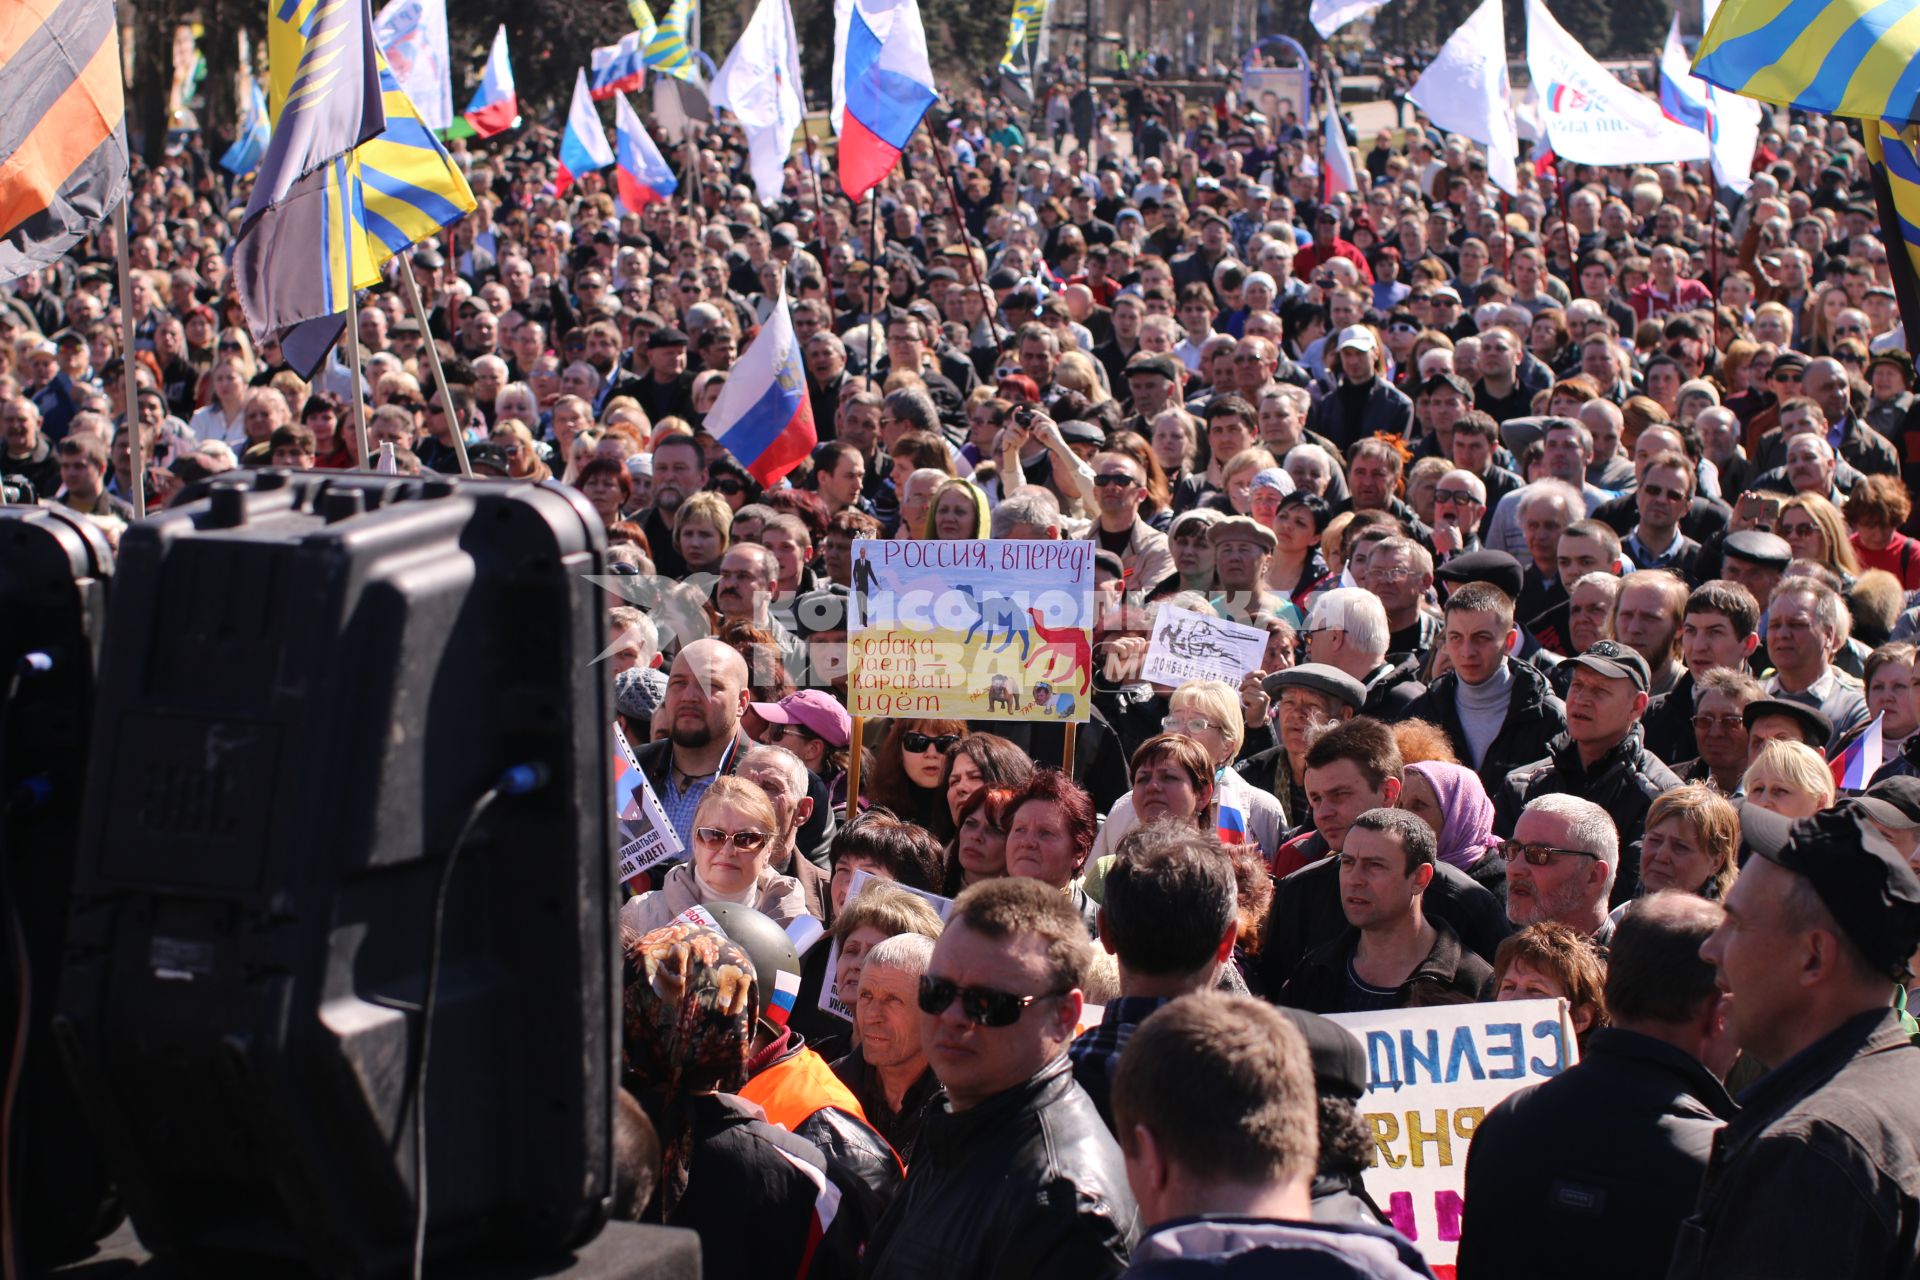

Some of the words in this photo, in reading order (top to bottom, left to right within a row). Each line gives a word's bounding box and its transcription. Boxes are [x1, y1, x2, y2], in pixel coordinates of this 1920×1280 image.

[884, 541, 994, 573] РОССИЯ,
[852, 631, 934, 657] собака
[855, 657, 917, 672] лает
[853, 672, 952, 690] караван
[857, 692, 941, 716] идёт
[619, 830, 662, 861] РАЩАТЬСЯ!
[635, 841, 668, 868] ЖДЕТ!
